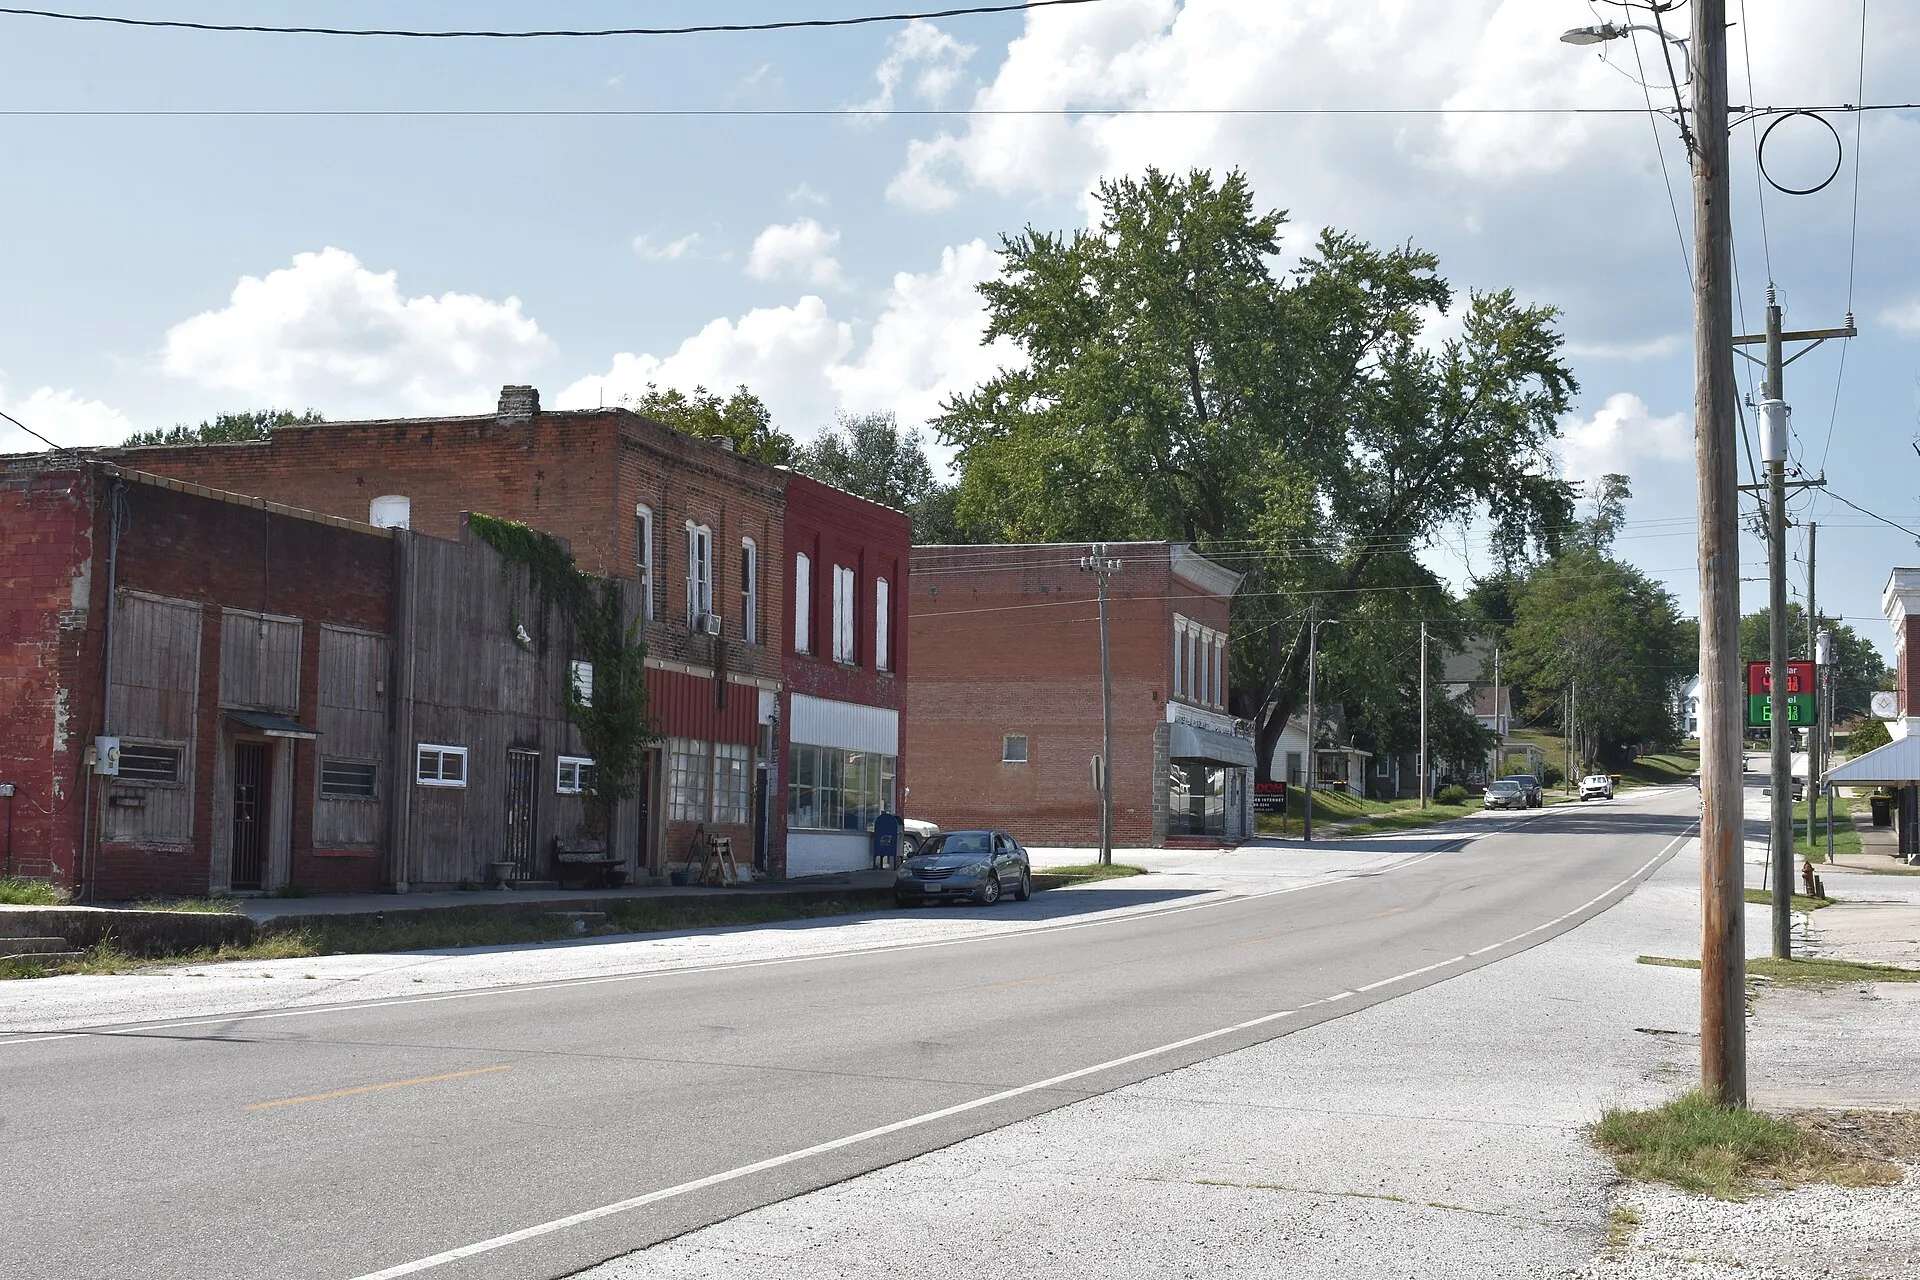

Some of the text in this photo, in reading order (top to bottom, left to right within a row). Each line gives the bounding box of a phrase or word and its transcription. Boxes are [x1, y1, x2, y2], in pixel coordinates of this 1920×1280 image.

[1765, 667, 1798, 675] Rlar
[1767, 696, 1797, 704] Del
[1255, 784, 1284, 792] DOM
